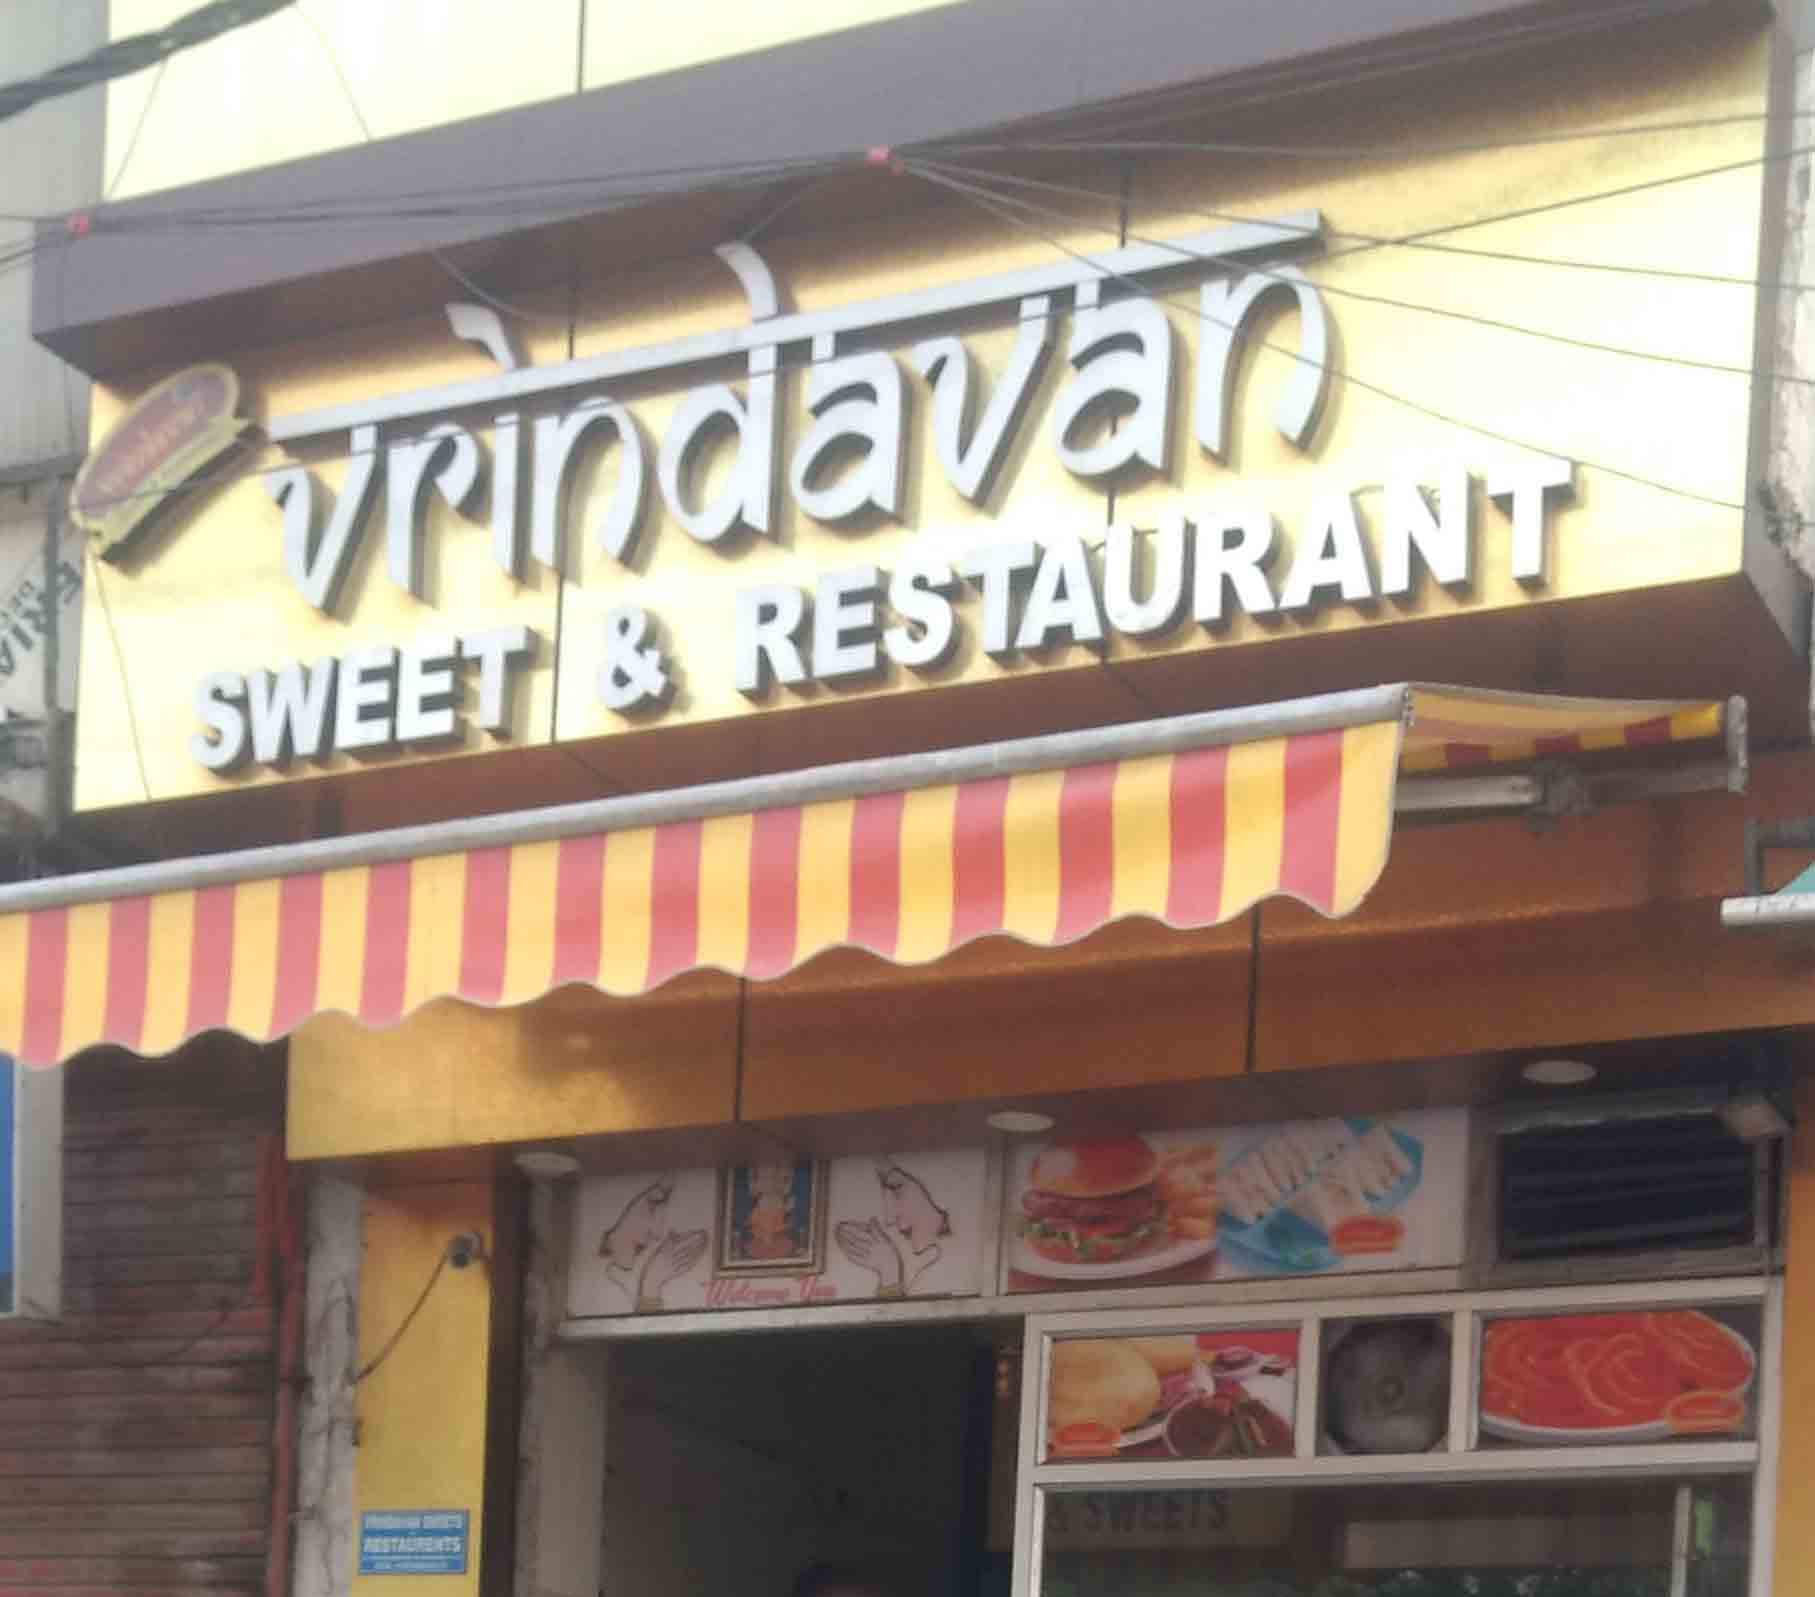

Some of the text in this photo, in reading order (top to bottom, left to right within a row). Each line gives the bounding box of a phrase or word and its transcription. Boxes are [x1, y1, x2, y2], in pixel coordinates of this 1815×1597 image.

[192, 458, 1575, 770] SWEET & RESTAURANT
